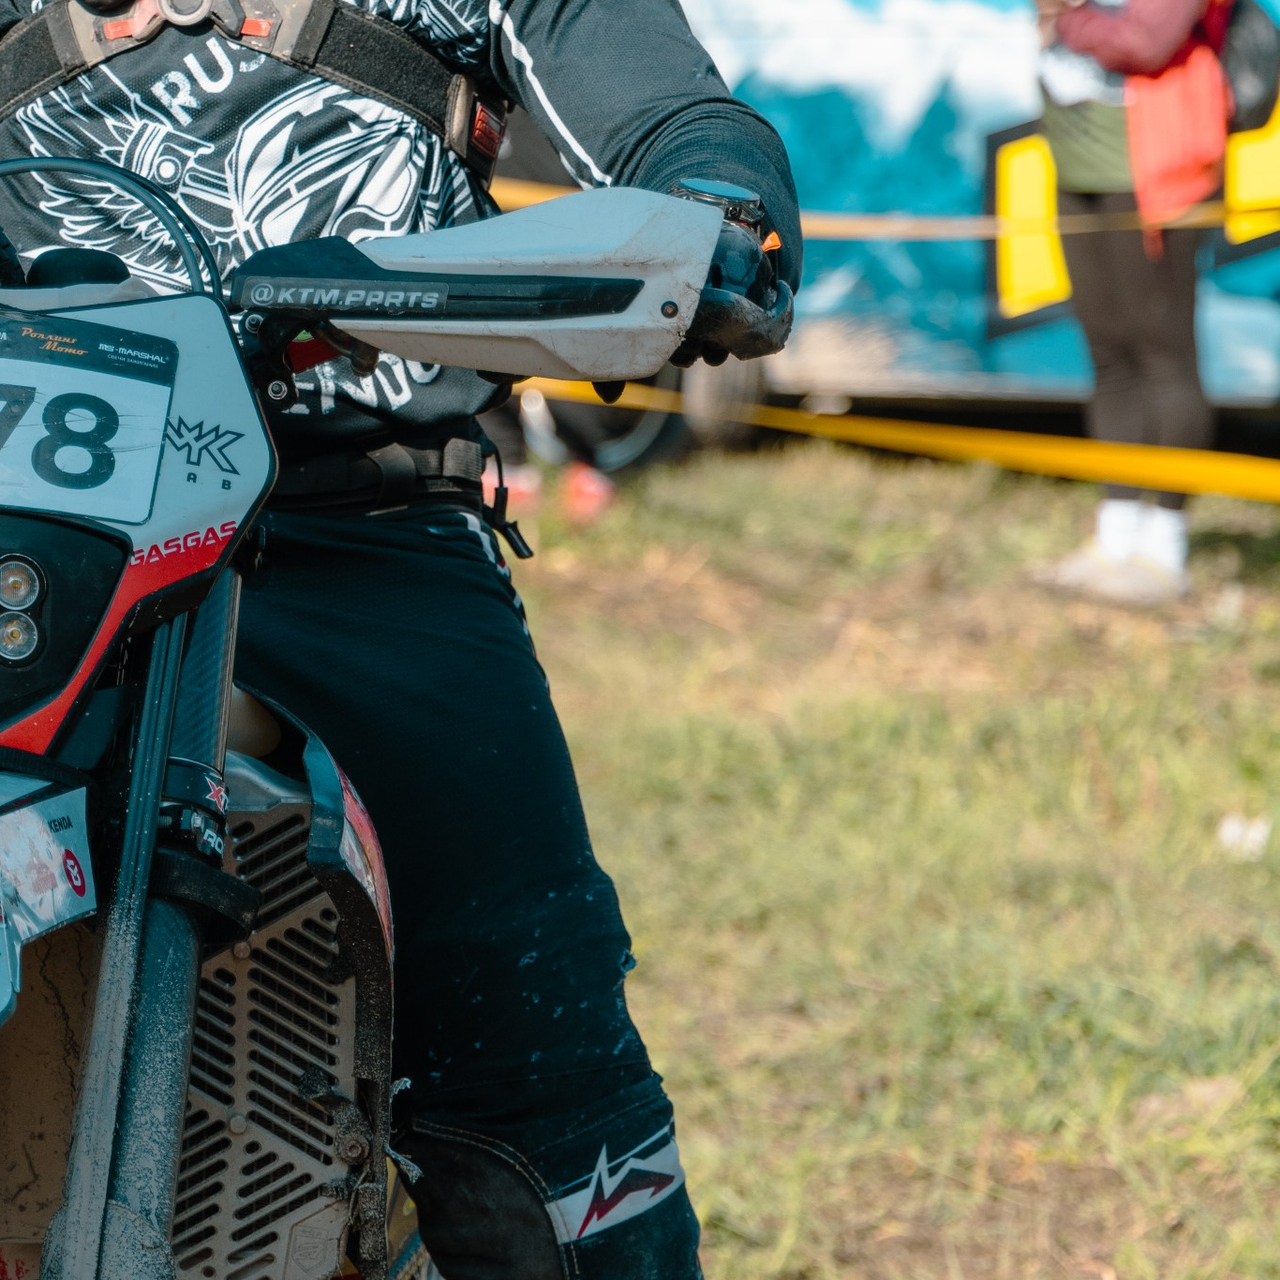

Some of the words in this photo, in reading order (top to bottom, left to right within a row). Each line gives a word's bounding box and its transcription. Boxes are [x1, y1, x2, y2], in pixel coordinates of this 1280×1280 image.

[251, 283, 440, 309] @KTM.PARTS
[129, 520, 238, 566] GASGAS
[48, 816, 74, 833] KENDA
